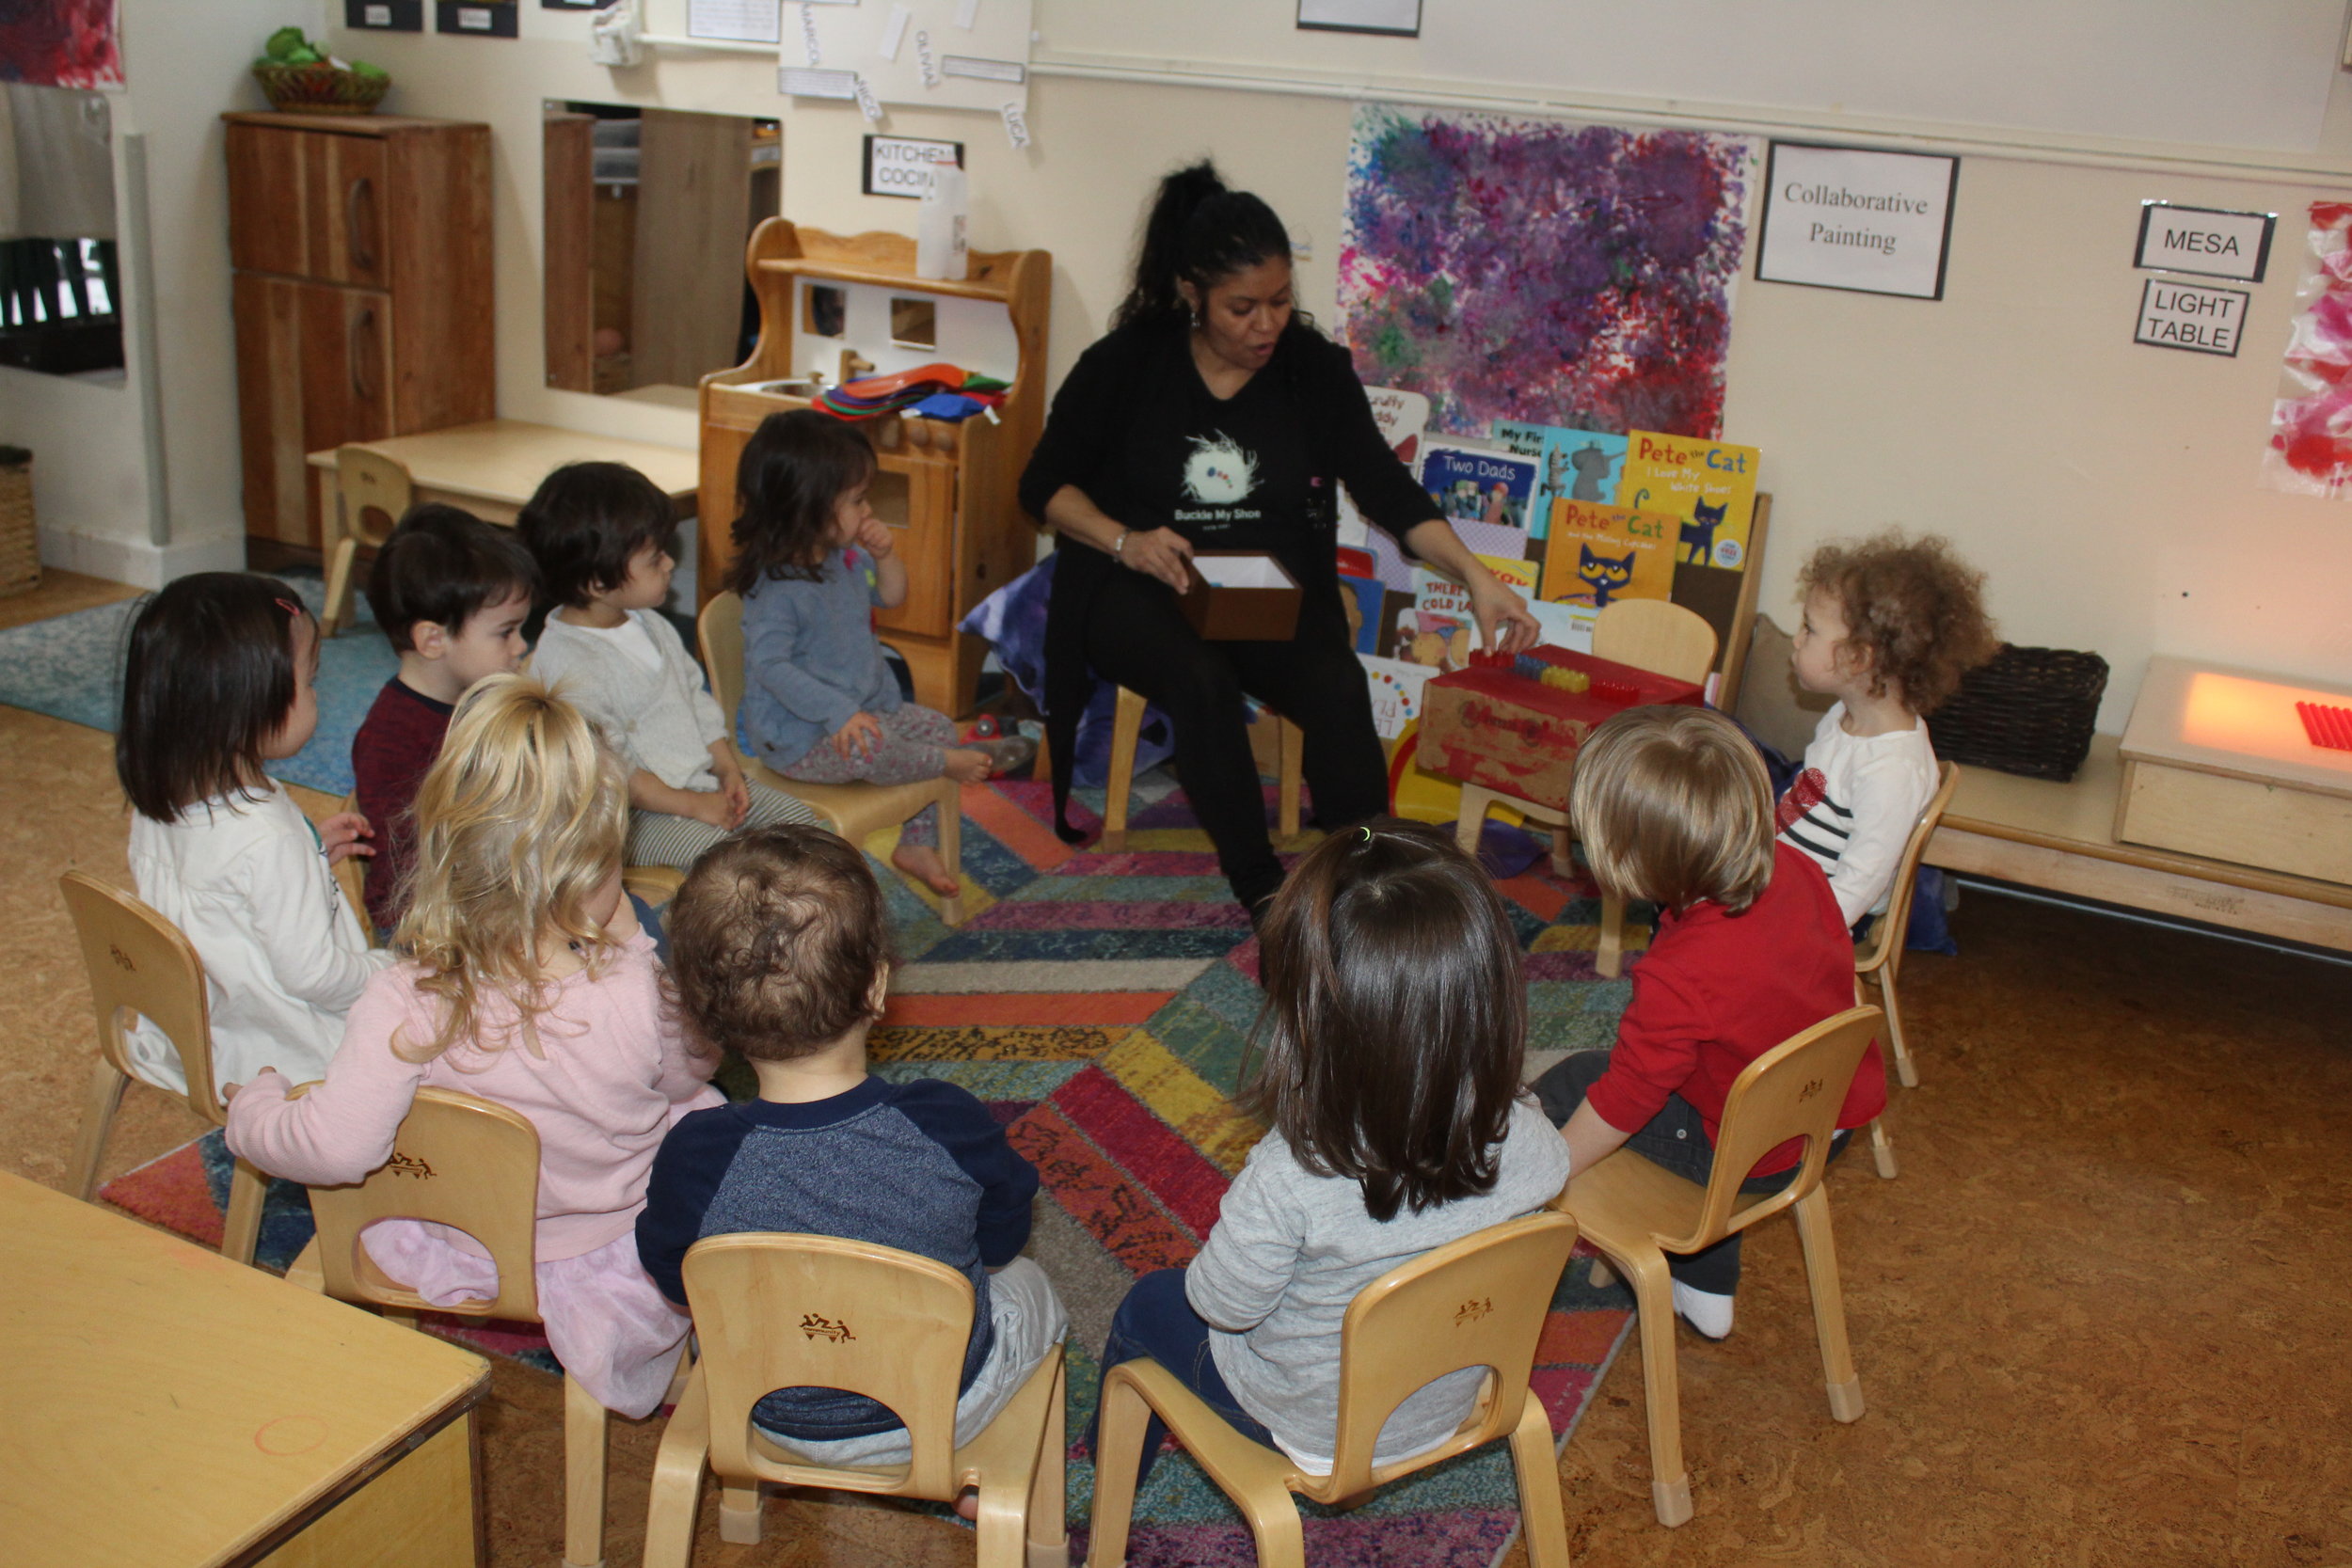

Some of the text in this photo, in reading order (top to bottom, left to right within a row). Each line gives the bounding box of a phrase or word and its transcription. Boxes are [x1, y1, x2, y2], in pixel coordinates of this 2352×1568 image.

[915, 30, 934, 88] OLIVIA
[1003, 103, 1025, 147] LUCA
[1784, 182, 1929, 214] Collaborative
[1809, 222, 1897, 255] Painting
[2164, 229, 2239, 256] MESA
[2154, 290, 2234, 318] LIGHT
[2148, 318, 2230, 348] TABLE
[1502, 429, 1521, 443] My
[1443, 455, 1517, 482] Two Dads
[1639, 437, 1747, 474] Pete the Cat
[1654, 467, 1677, 479] Love
[1681, 468, 1701, 482] My
[1670, 481, 1732, 495] White Shoes
[1174, 508, 1262, 522] Buckle My Shoe
[1565, 503, 1664, 539] Pete the Cat
[1426, 582, 1465, 596] THERE
[1422, 599, 1454, 611] COLD
